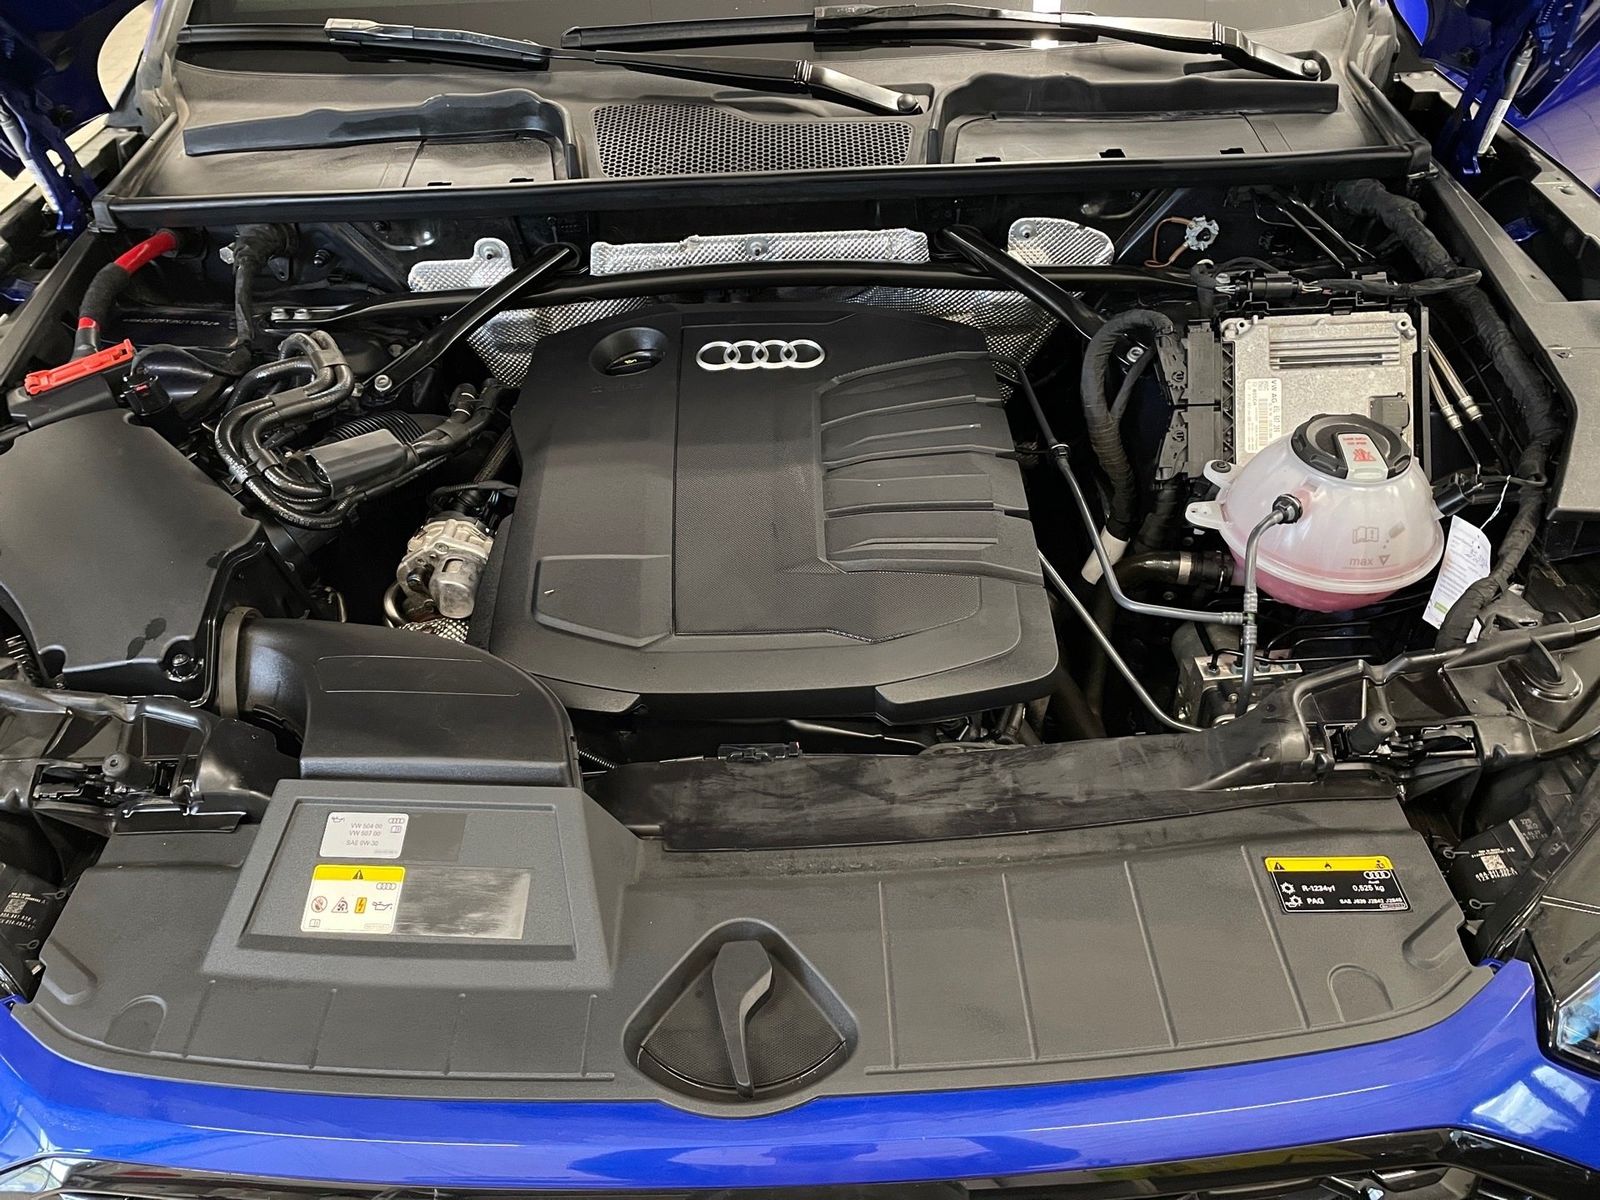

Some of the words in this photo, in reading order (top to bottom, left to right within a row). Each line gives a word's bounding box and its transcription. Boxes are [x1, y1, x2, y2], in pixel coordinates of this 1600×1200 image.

[1271, 379, 1277, 392] VW
[1271, 393, 1278, 404] AG
[1349, 557, 1374, 566] max
[1352, 884, 1373, 893] 0,525
[1374, 884, 1386, 893] kg
